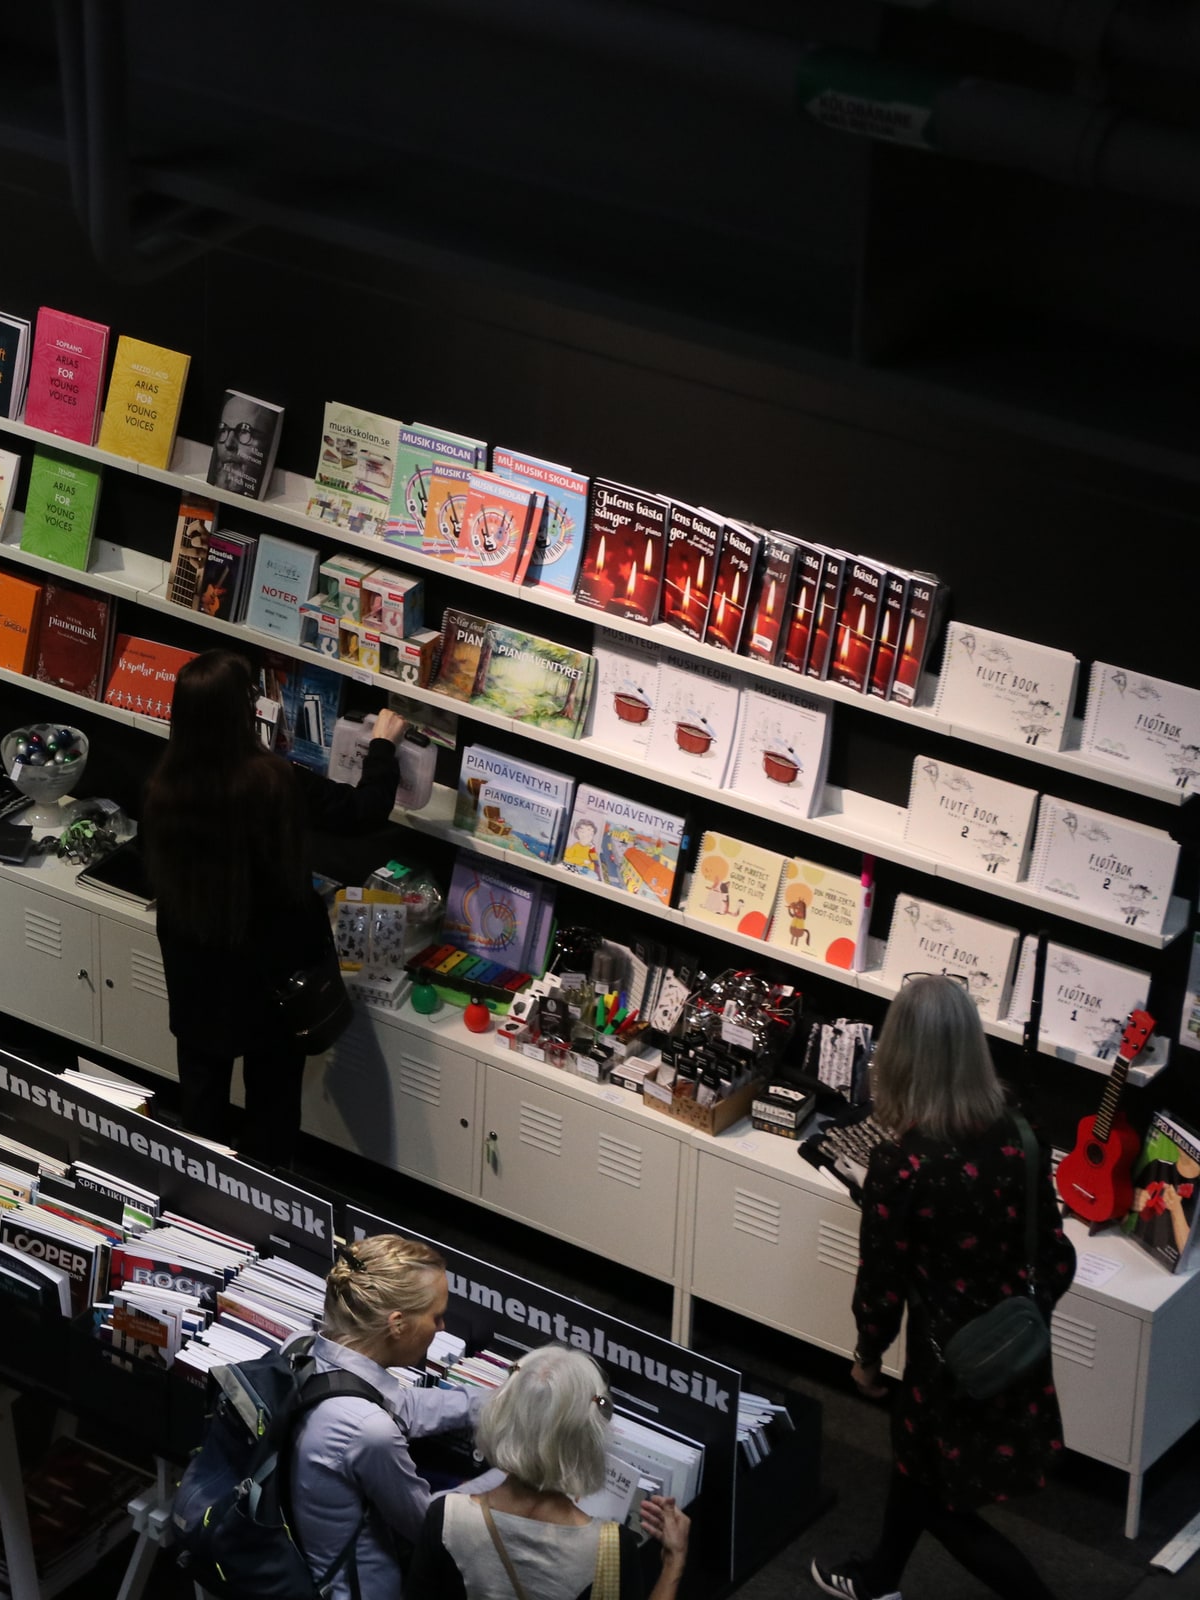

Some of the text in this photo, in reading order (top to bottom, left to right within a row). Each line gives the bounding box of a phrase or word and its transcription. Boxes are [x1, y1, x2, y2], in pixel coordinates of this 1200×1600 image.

[55, 339, 83, 354] SOPRANO
[56, 355, 79, 370] ARIAS
[57, 368, 74, 380] FOR
[50, 377, 79, 394] YOUNG
[135, 380, 159, 394] ARIAS
[49, 389, 77, 406] VOICES
[136, 392, 152, 405] FOR
[127, 403, 158, 420] YOUNG
[125, 415, 155, 432] VOICES
[329, 420, 391, 448] musikskolan.se
[402, 432, 431, 449] MUSIK
[435, 443, 471, 460] SKOLAN
[58, 467, 76, 478] TENOR
[434, 466, 461, 479] MUSIK
[514, 464, 544, 480] MUSIK
[548, 474, 584, 492] SKOLAN
[53, 481, 76, 495] ARIAS
[472, 479, 494, 491] MUSIK
[498, 487, 528, 503] SKOLAN
[54, 494, 71, 506] FOR
[596, 490, 663, 522] Julens bästa
[46, 503, 75, 520] YOUNG
[45, 515, 73, 532] VOICES
[594, 507, 662, 537] sånger för piano
[692, 518, 716, 540] bästa
[729, 533, 751, 556] bästa
[208, 554, 224, 564] gitarr
[209, 548, 234, 561] Akustisk
[770, 546, 790, 564] ästa
[853, 565, 878, 587] bästa
[261, 585, 298, 605] NOTER
[49, 615, 97, 641] pianomusik
[457, 630, 484, 647] PIAN
[118, 658, 127, 671] Vi
[127, 662, 153, 677] spelar
[668, 656, 732, 682] MUSIKTEORI
[977, 666, 1007, 684] FLUTE
[1012, 675, 1040, 694] BOOK
[755, 683, 819, 712] MUSIKTEORI
[467, 755, 559, 796] PIANOÄVENTYR 1
[484, 789, 552, 818] PIANOSKATTEN
[939, 796, 999, 825] FLUTE BOOK
[587, 795, 685, 835] PIANOÄVENTYR 2
[961, 825, 970, 838] 2
[731, 881, 747, 892] TOOT
[747, 877, 756, 886] TO
[1103, 877, 1111, 890] 2
[919, 937, 980, 967] FLUTE BOOK
[1070, 1010, 1078, 1022] 1
[3, 1228, 86, 1276] LOOPER
[133, 1267, 215, 1300] ROCK
[618, 1472, 631, 1488] jag
